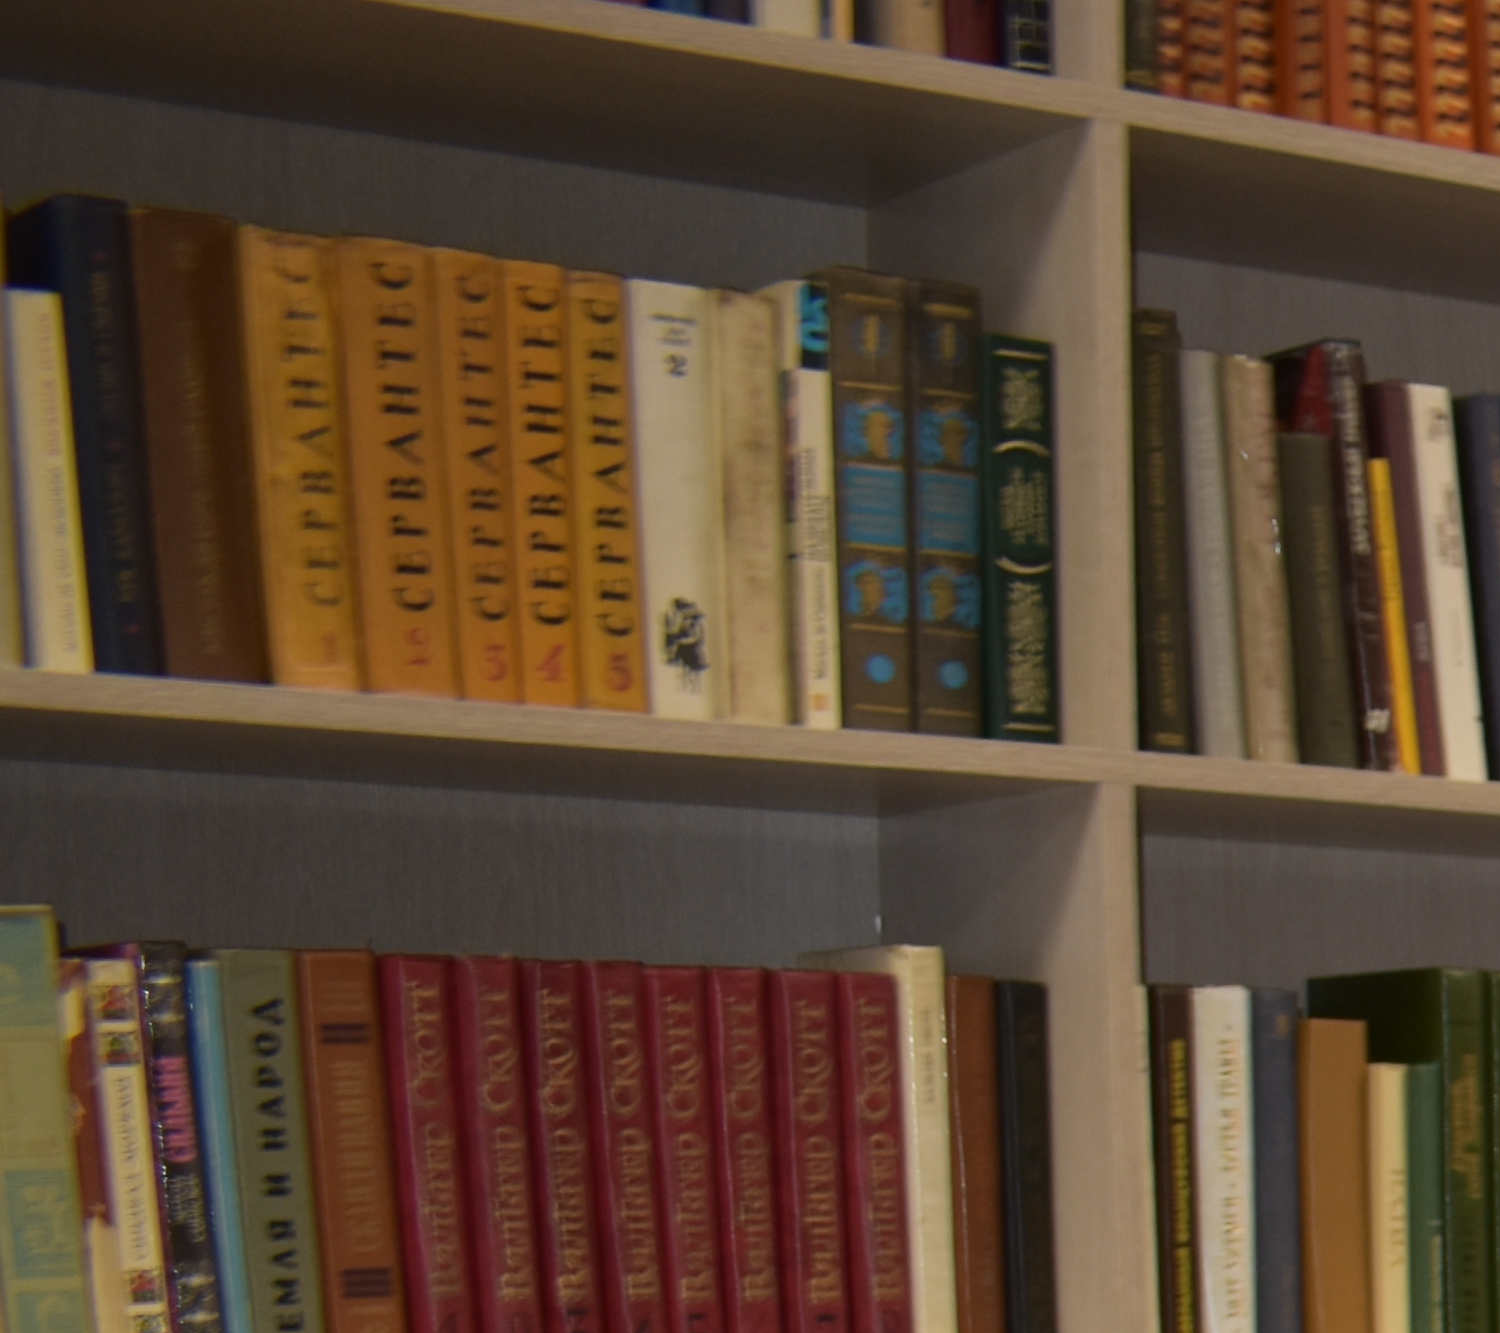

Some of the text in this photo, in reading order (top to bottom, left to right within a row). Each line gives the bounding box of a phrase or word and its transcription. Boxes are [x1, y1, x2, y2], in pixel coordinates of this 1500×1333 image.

[274, 263, 342, 606] СЕРВАНТЕС
[370, 262, 433, 612] СЕРВАНТЕС
[457, 276, 510, 620] СЕРВАНТЕС
[518, 285, 570, 626] СЕРВАНТЕС
[583, 297, 634, 638] СЕРВАНТЕС
[405, 627, 429, 666] 2
[484, 645, 508, 683] 3
[535, 643, 567, 683] 4
[606, 653, 633, 691] 5
[252, 996, 289, 1153] НАРОД
[265, 1173, 292, 1198] И
